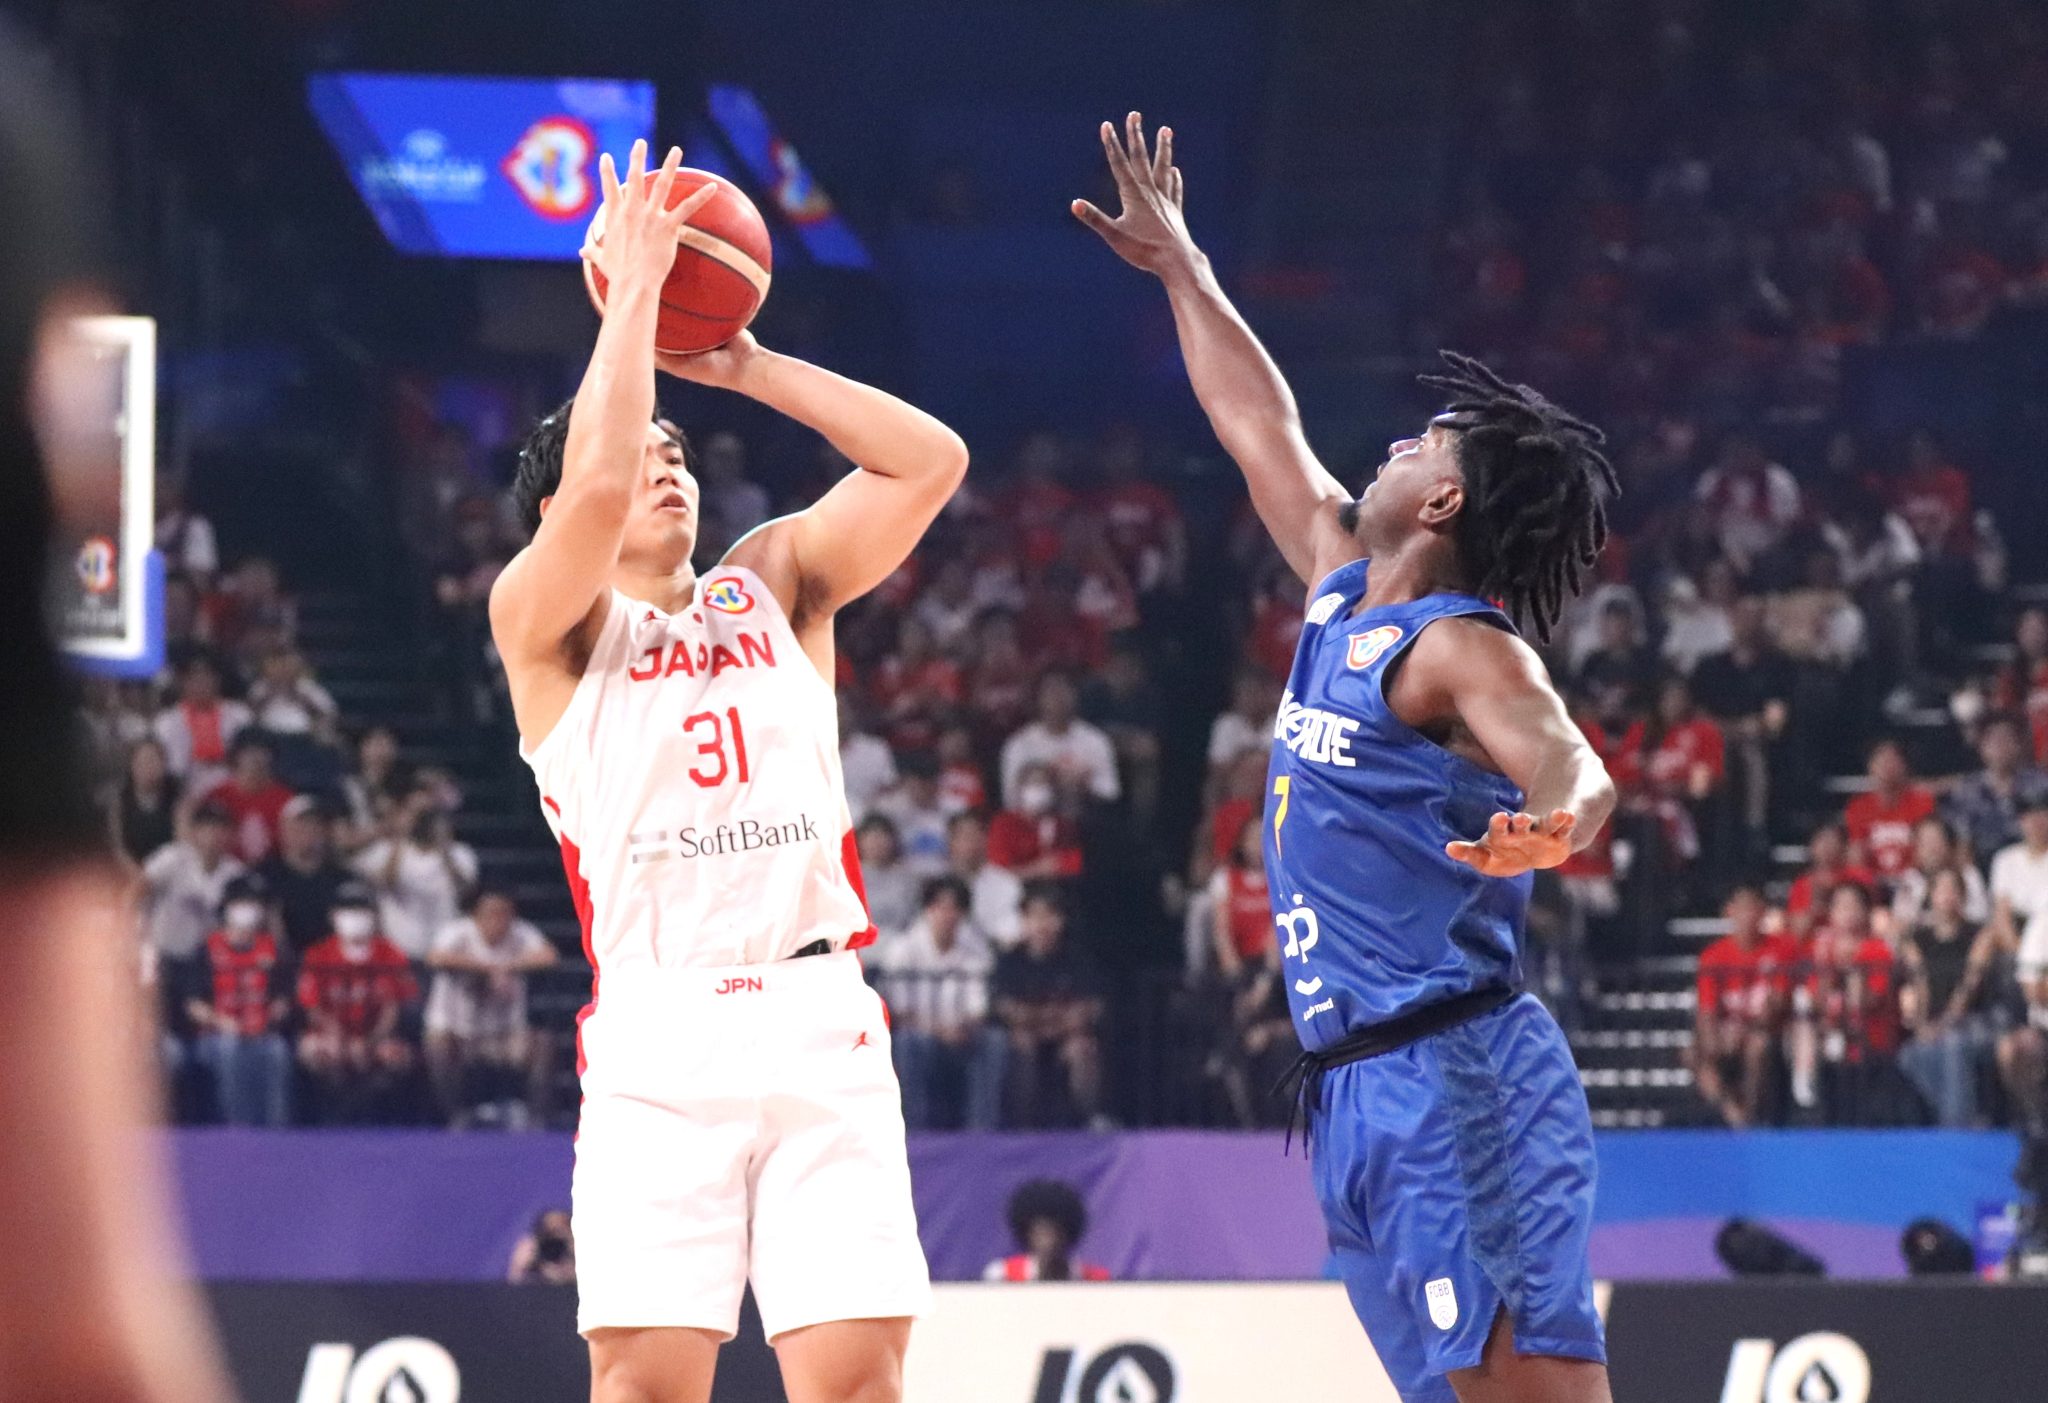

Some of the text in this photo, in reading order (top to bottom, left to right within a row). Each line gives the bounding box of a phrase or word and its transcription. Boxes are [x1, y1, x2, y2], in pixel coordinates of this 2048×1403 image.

[629, 632, 776, 681] JAPAN
[682, 707, 749, 788] 31
[679, 813, 819, 858] SoftBank
[715, 976, 763, 995] JPN
